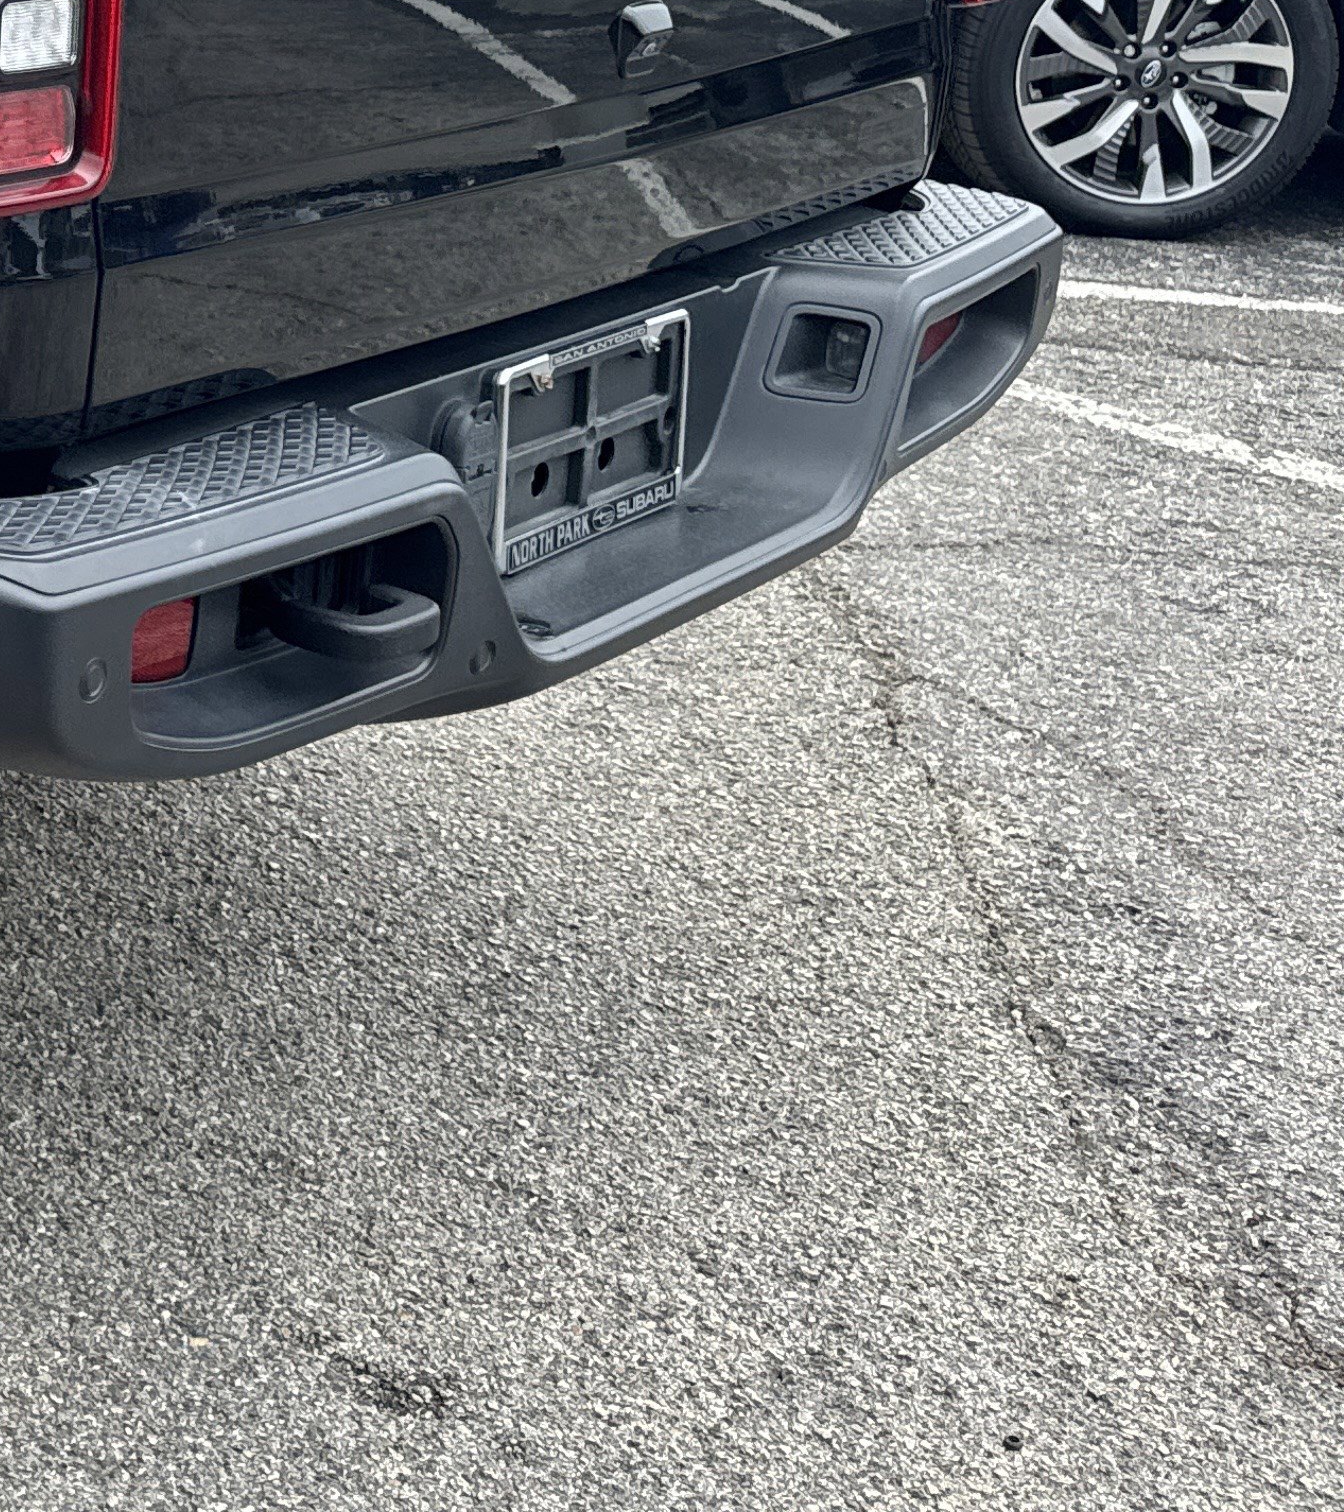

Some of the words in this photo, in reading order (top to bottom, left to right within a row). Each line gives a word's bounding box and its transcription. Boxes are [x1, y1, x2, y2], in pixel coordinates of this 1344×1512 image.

[554, 348, 583, 365] SAN
[587, 327, 646, 353] ANTONIO
[511, 529, 554, 568] NORTH
[557, 513, 591, 548] PARK
[615, 480, 674, 520] SUBARU
